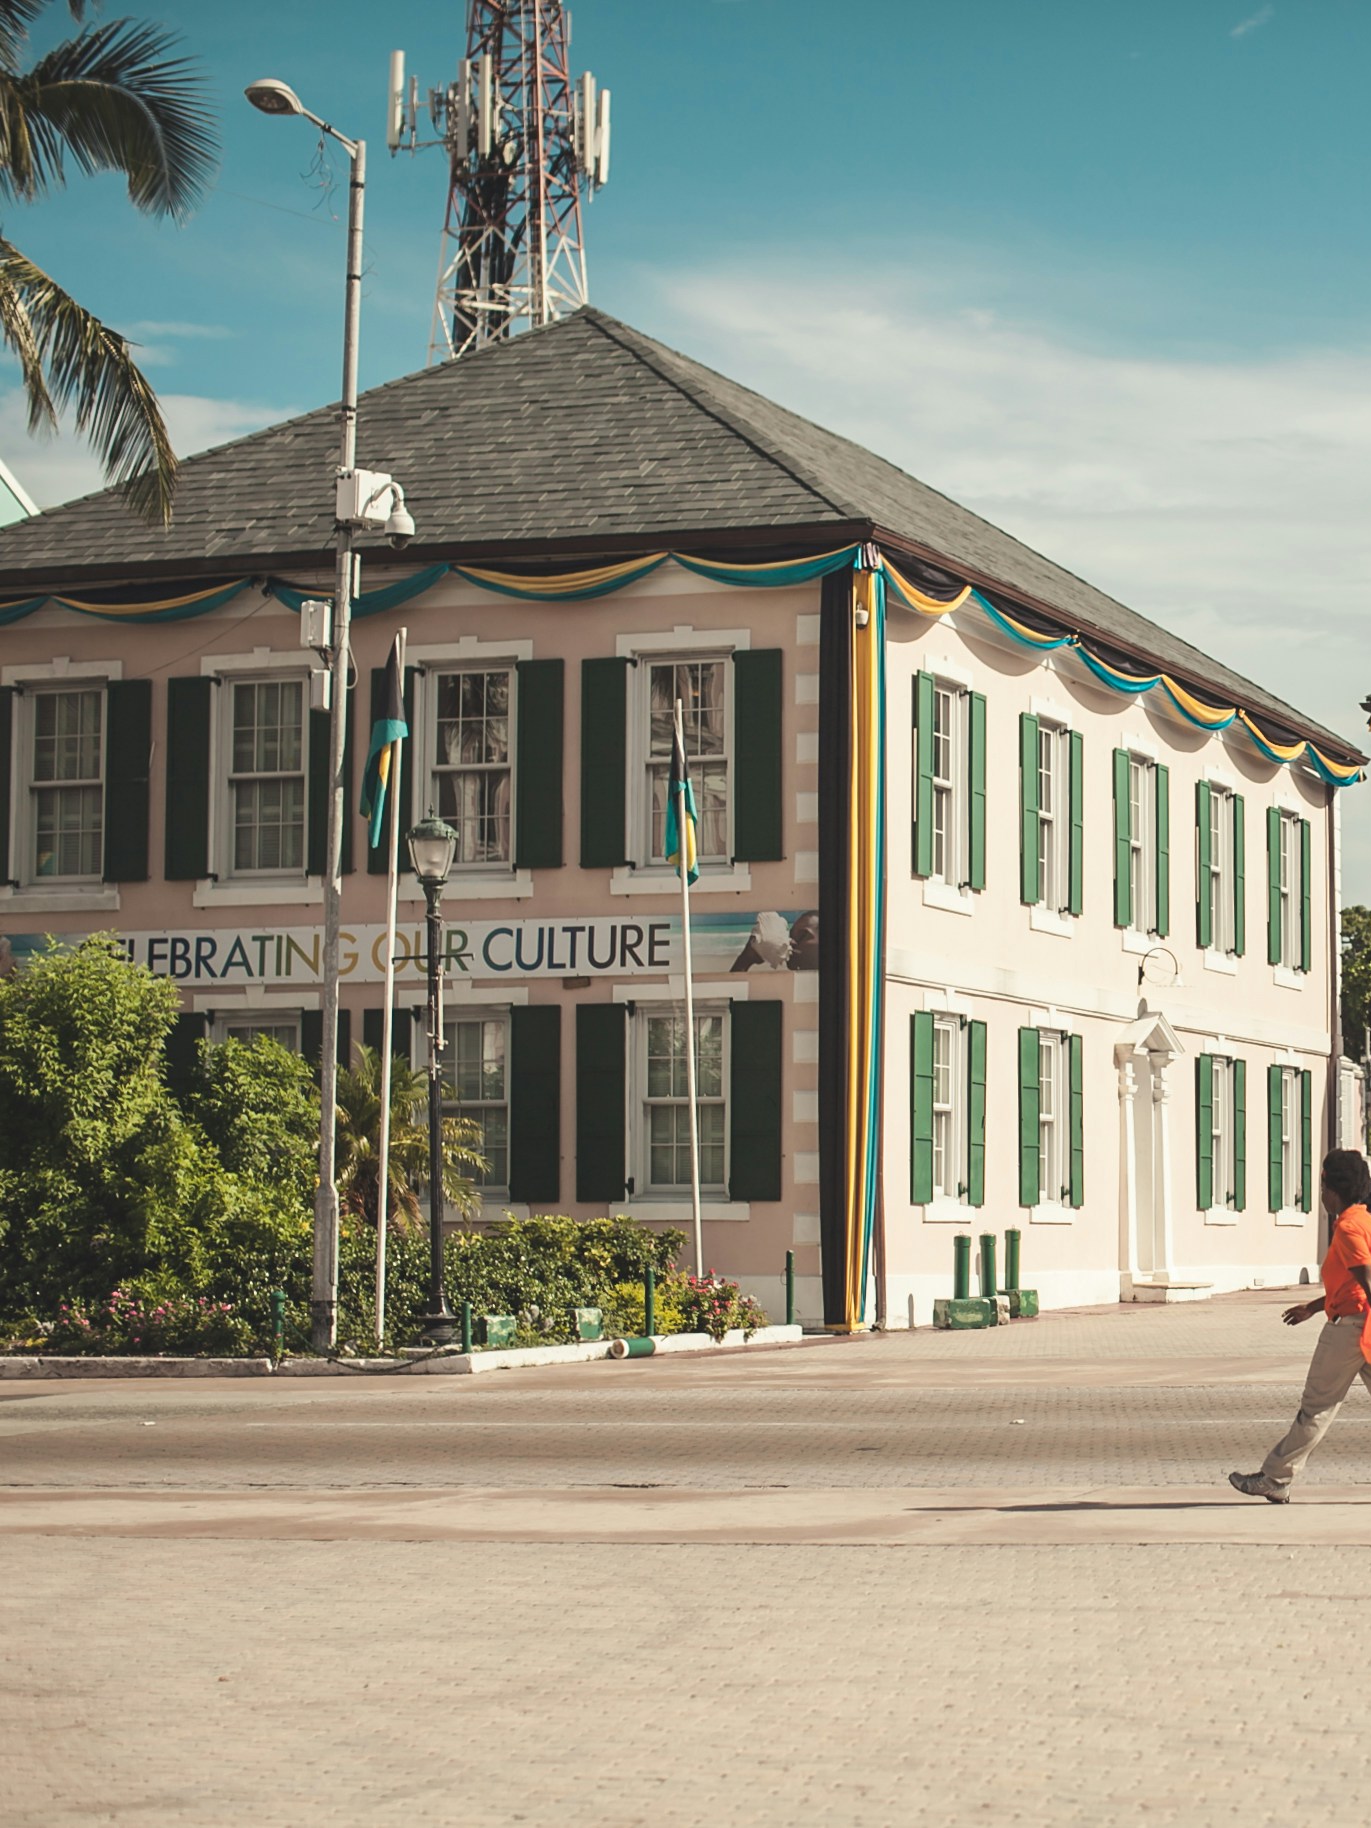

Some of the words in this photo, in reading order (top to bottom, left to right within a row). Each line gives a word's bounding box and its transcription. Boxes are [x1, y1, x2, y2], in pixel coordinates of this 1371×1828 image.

[79, 932, 359, 980] EBRATING
[371, 929, 469, 974] OUR
[482, 923, 671, 972] CULTURE
